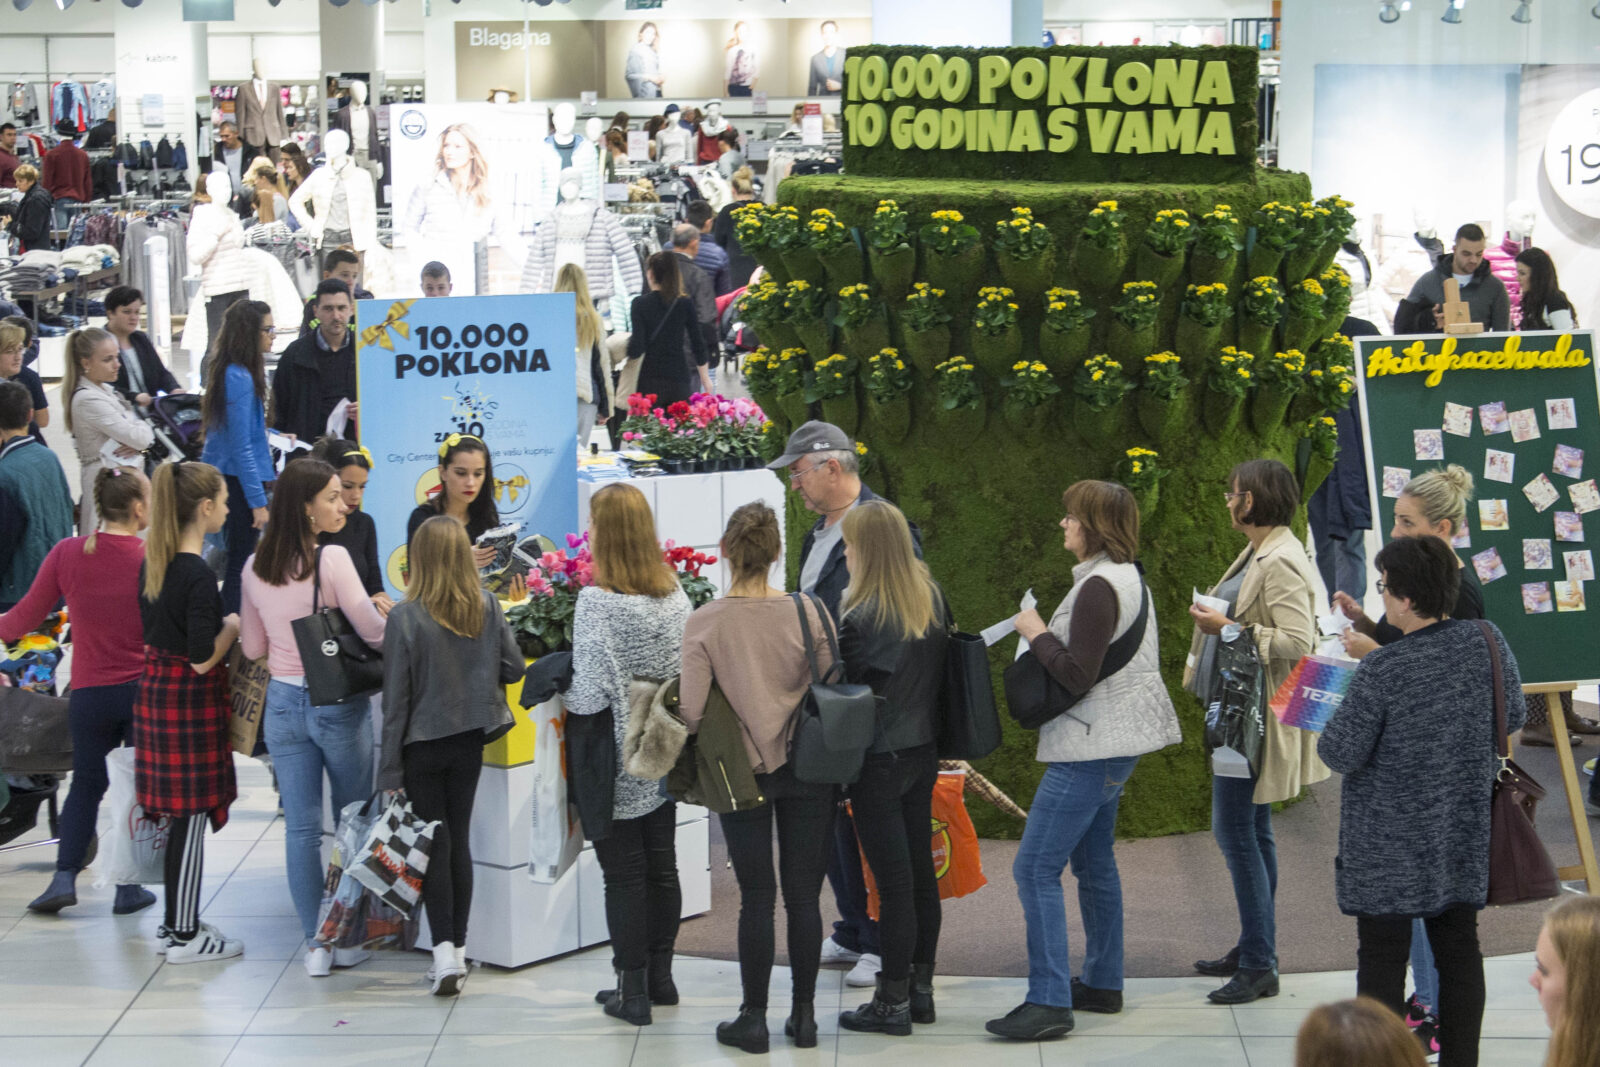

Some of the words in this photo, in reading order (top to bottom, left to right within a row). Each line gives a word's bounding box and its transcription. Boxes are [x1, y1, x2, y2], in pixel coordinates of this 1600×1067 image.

[469, 27, 551, 51] Blagajna
[845, 53, 972, 103] 10.000
[979, 55, 1235, 107] POKLONA
[844, 102, 887, 147] 10
[891, 105, 1045, 152] GODINA
[1047, 107, 1079, 153] S
[1085, 108, 1236, 155] VAMA
[414, 322, 529, 350] 10.000
[395, 348, 551, 379] POKLONA
[457, 421, 485, 440] 10
[387, 453, 405, 464] City
[231, 692, 260, 723] OVE
[1302, 686, 1344, 706] TEZE
